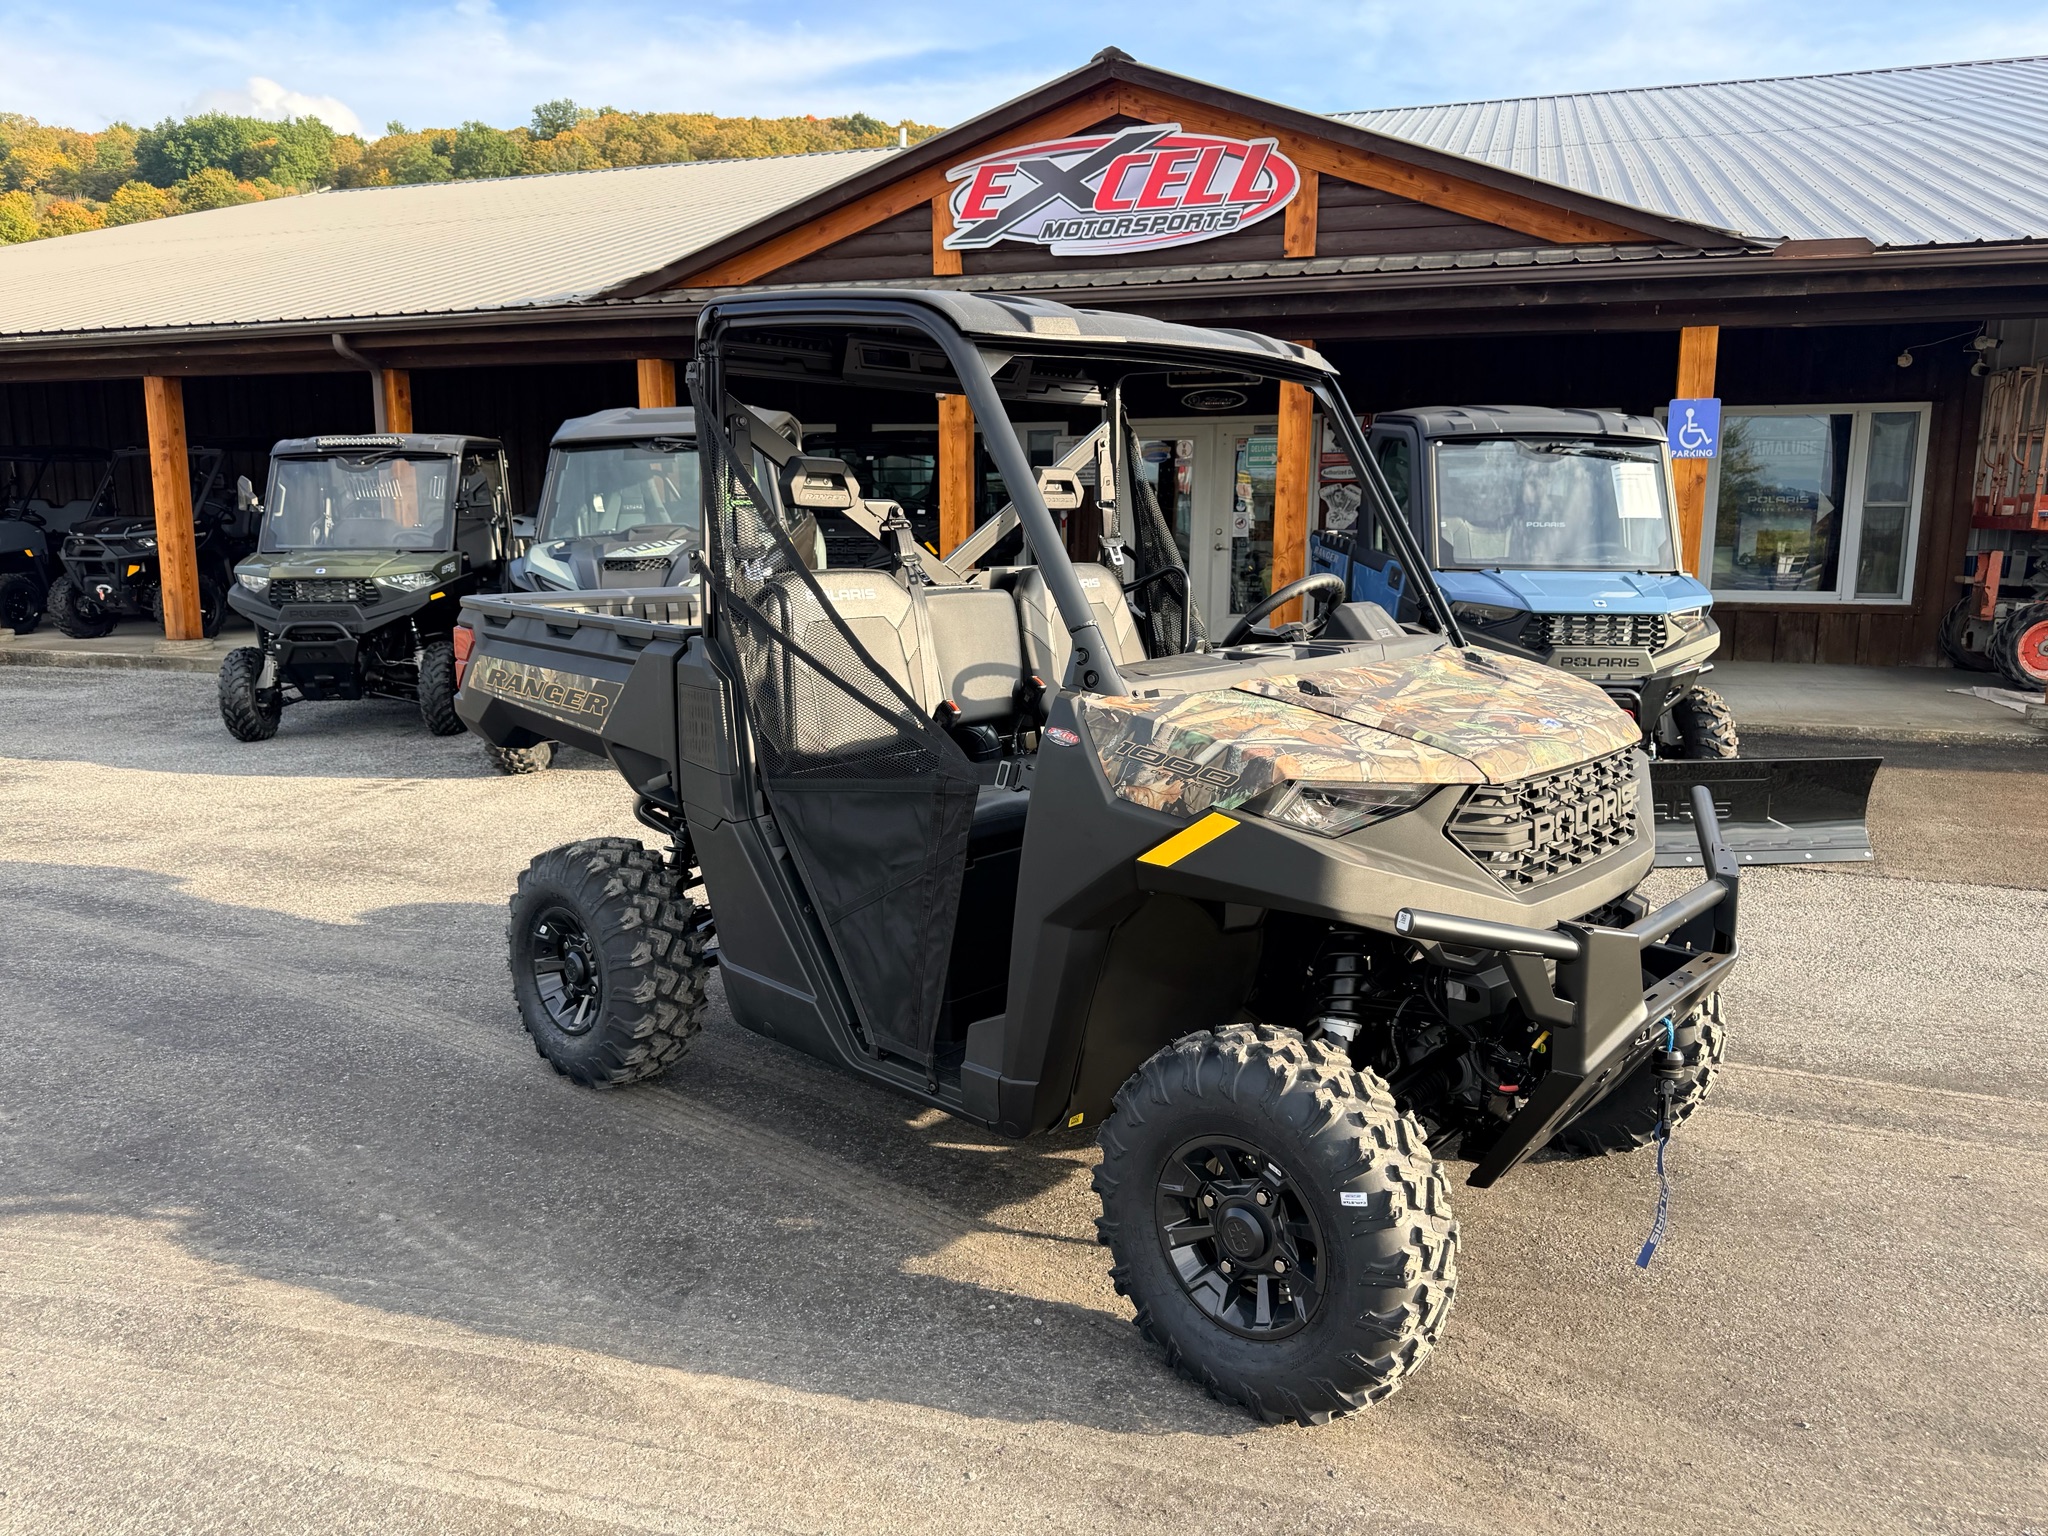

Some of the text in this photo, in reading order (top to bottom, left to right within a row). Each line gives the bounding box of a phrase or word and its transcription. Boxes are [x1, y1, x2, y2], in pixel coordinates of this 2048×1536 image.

[953, 130, 1272, 242] EXCELL
[1040, 210, 1242, 241] MOTORSPORTS
[1251, 444, 1277, 452] DELIVERIE
[1671, 449, 1713, 458] PARKING
[805, 493, 846, 501] RANGER
[1313, 546, 1339, 563] RANGER
[815, 588, 877, 601] LARIS
[289, 609, 350, 618] POLARIS
[1560, 656, 1640, 668] POLARIS
[486, 667, 609, 717] RANGER
[1115, 739, 1241, 788] 1000
[1534, 782, 1635, 850] POLARIS
